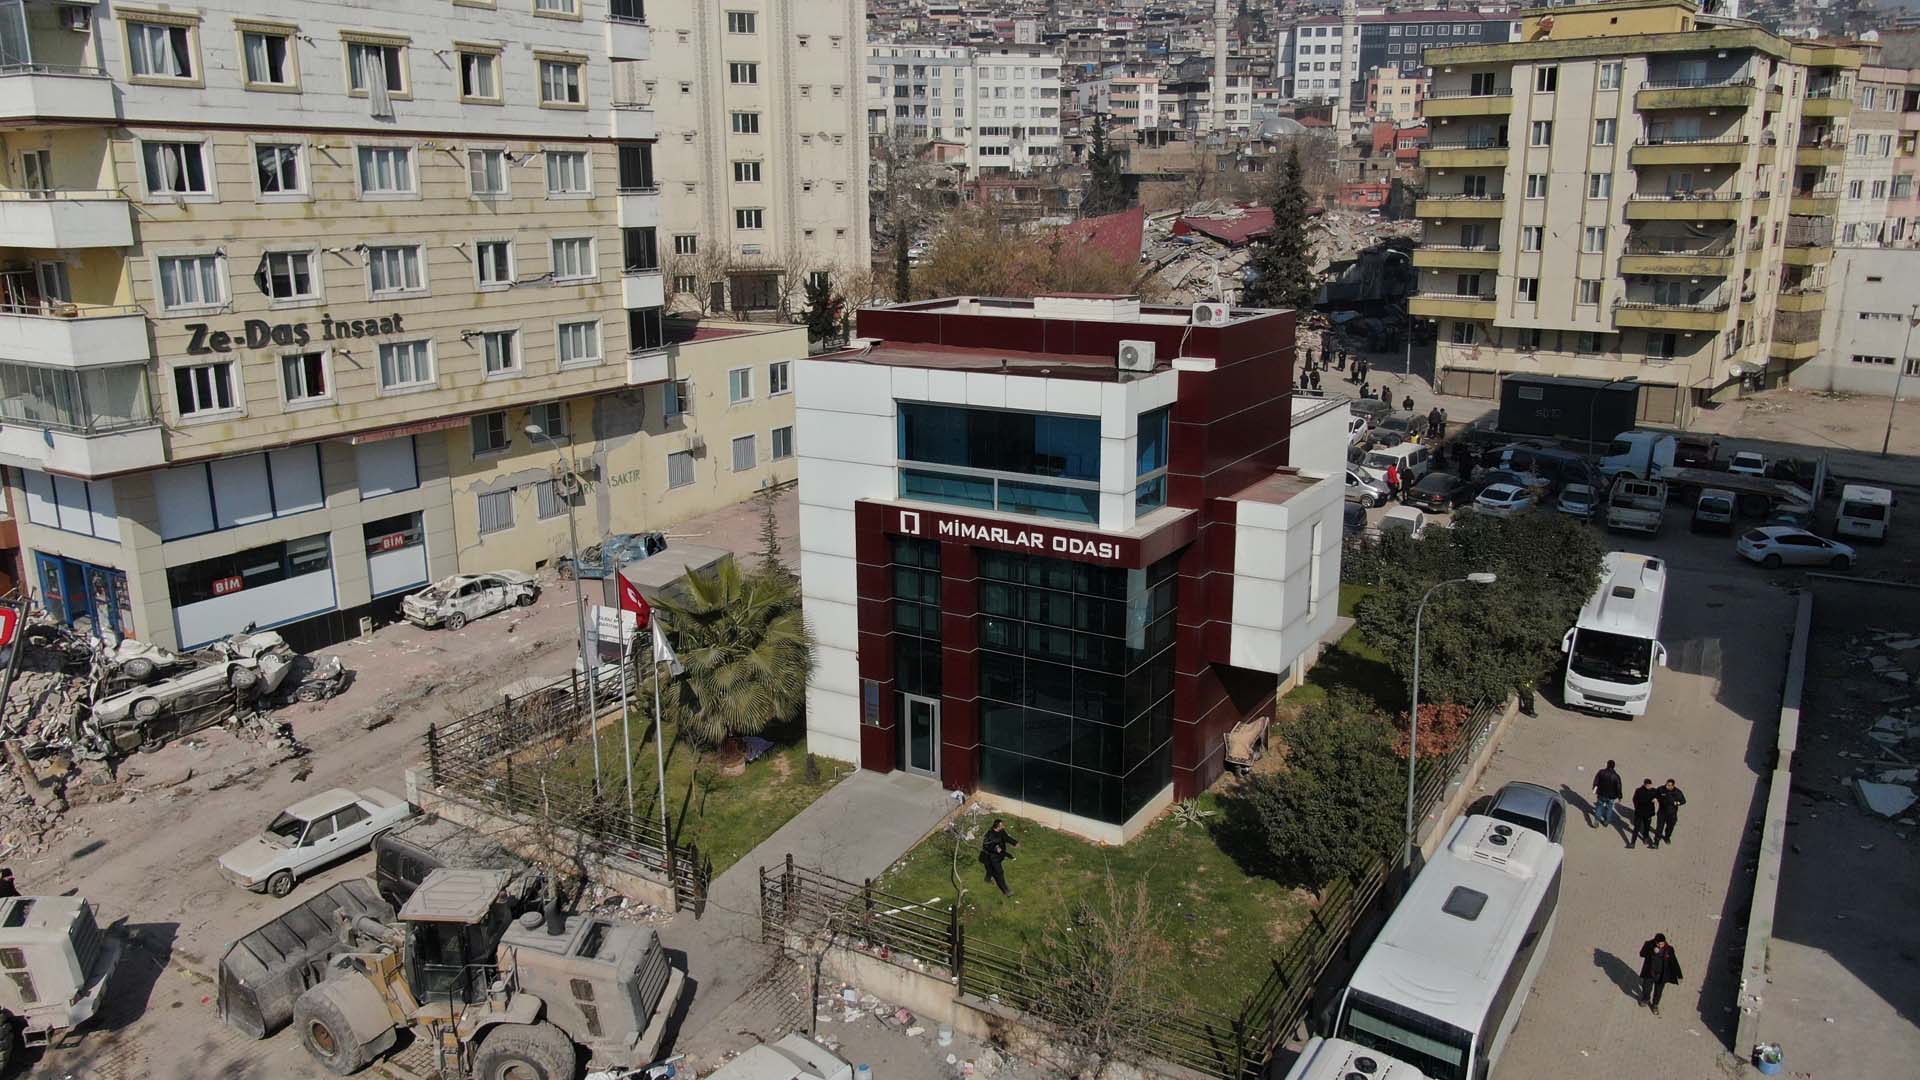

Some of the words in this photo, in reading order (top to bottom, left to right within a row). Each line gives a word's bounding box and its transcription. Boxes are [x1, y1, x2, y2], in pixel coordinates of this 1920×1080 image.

[184, 319, 310, 355] Ze-Daş
[383, 535, 403, 549] BİM
[938, 519, 1044, 549] MİMARLAR
[1052, 536, 1120, 560] ODASI
[215, 578, 240, 593] BİM
